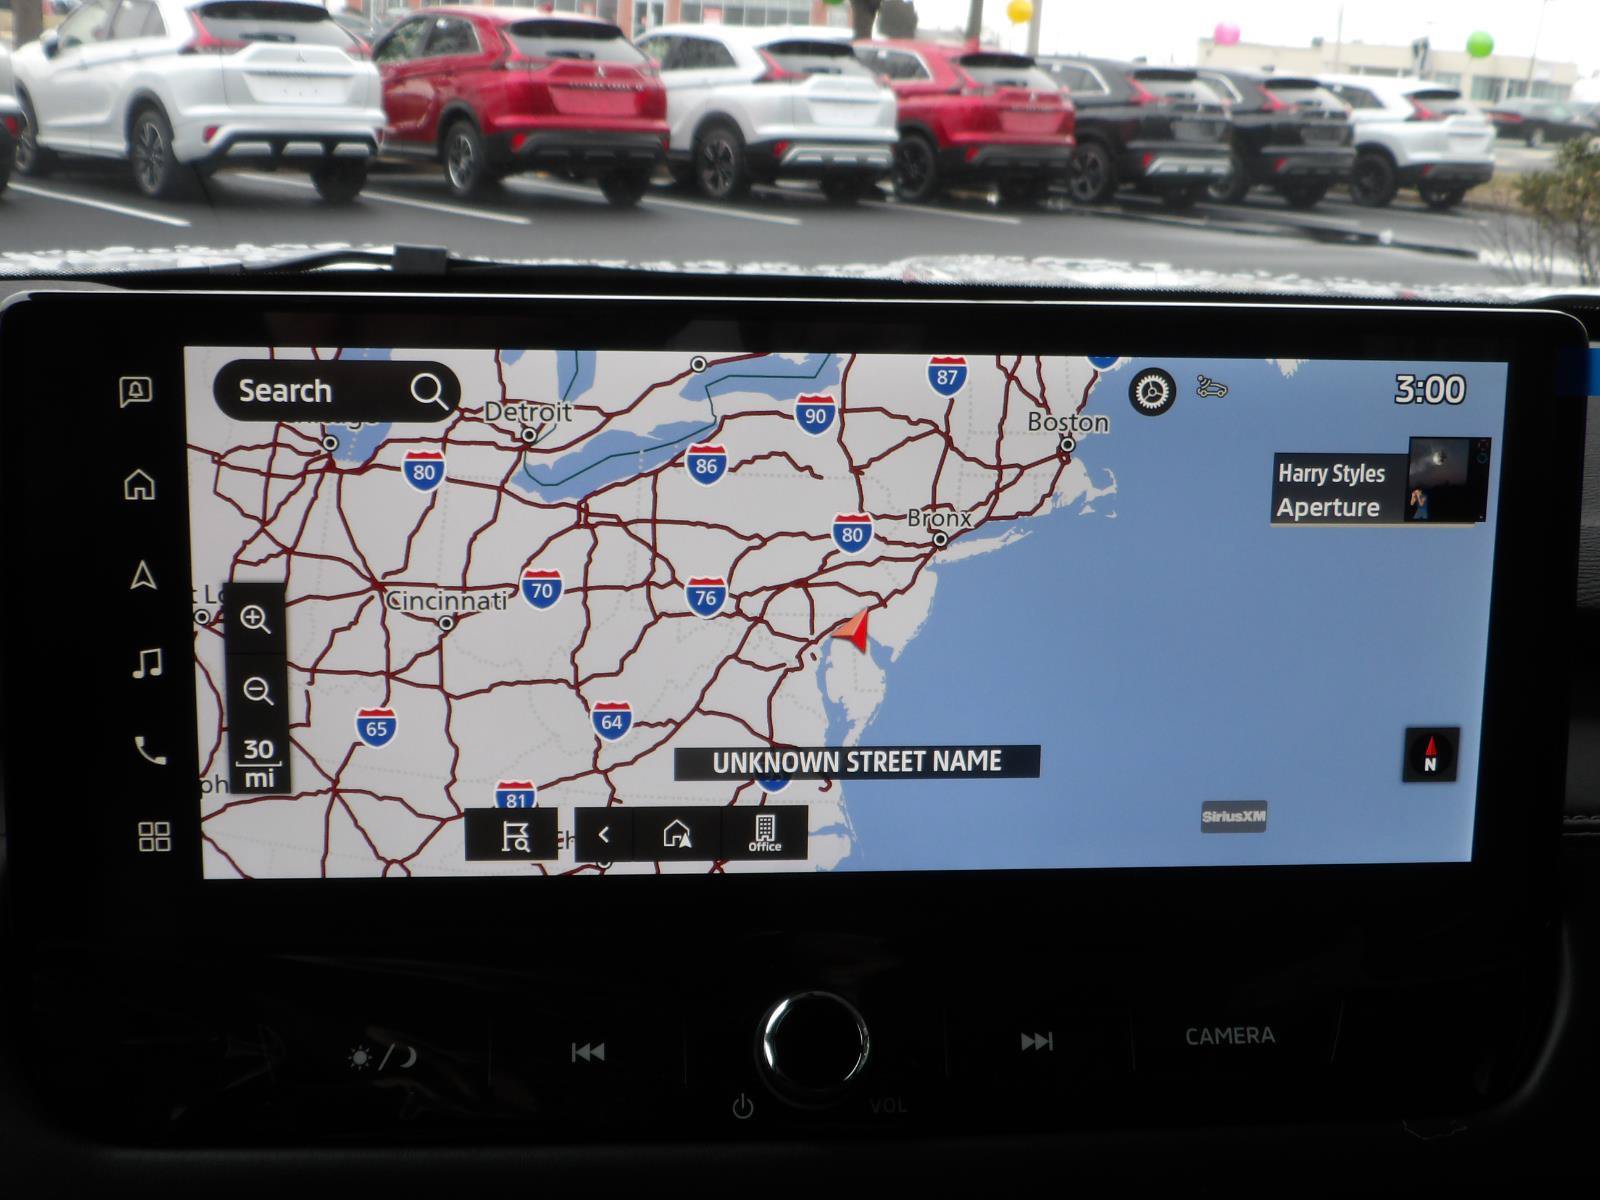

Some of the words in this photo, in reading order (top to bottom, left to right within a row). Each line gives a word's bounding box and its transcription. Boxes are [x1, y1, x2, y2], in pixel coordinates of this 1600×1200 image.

[937, 370, 958, 386] 87
[239, 377, 332, 403] Search
[1395, 373, 1467, 405] 3:00
[484, 400, 572, 422] Detroit
[805, 408, 827, 425] 90
[1028, 411, 1109, 432] Boston
[413, 464, 436, 481] 80
[695, 458, 718, 475] 86
[1278, 463, 1328, 486] Harry
[1332, 463, 1386, 486] Styles
[908, 508, 973, 528] Bronx
[1276, 497, 1381, 521] Aperture
[841, 527, 864, 543] 80
[531, 582, 554, 599] 70
[695, 590, 717, 607] 76
[386, 591, 508, 611] Cincinnati
[365, 721, 388, 737] 65
[601, 715, 623, 731] 64
[243, 739, 275, 760] 30
[712, 750, 840, 774] UNKNOWN
[846, 749, 928, 773] STREET
[932, 748, 1003, 772] NAME
[1424, 757, 1437, 772] N
[244, 767, 275, 788] mi
[506, 793, 526, 808] 81
[1202, 810, 1267, 824] SiriusXM
[748, 842, 782, 852] Office
[1185, 1026, 1276, 1046] CAMERA
[867, 1096, 908, 1115] VOL
